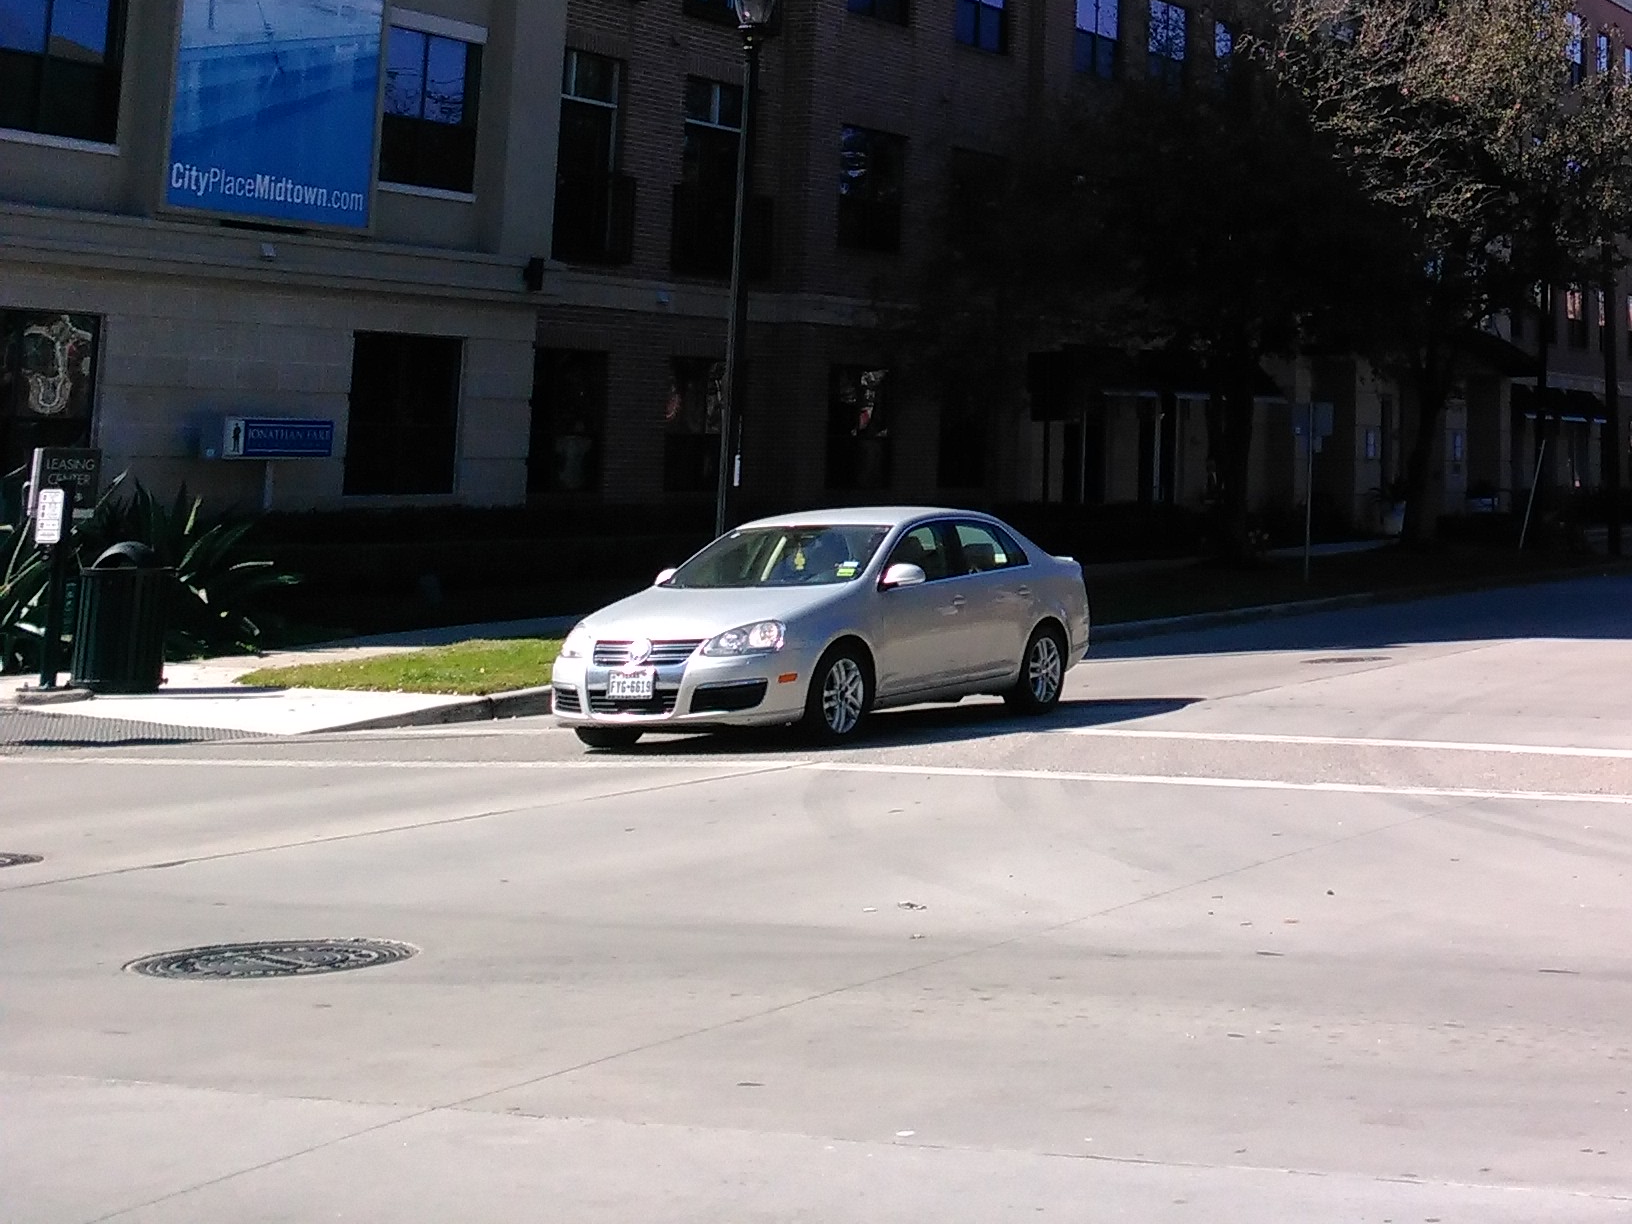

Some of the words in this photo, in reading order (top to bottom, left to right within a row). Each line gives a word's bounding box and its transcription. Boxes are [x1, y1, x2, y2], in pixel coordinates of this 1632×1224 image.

[171, 162, 364, 211] CityPlaceMidtown.com
[248, 428, 304, 440] JONATHAN
[46, 458, 95, 471] LEASING
